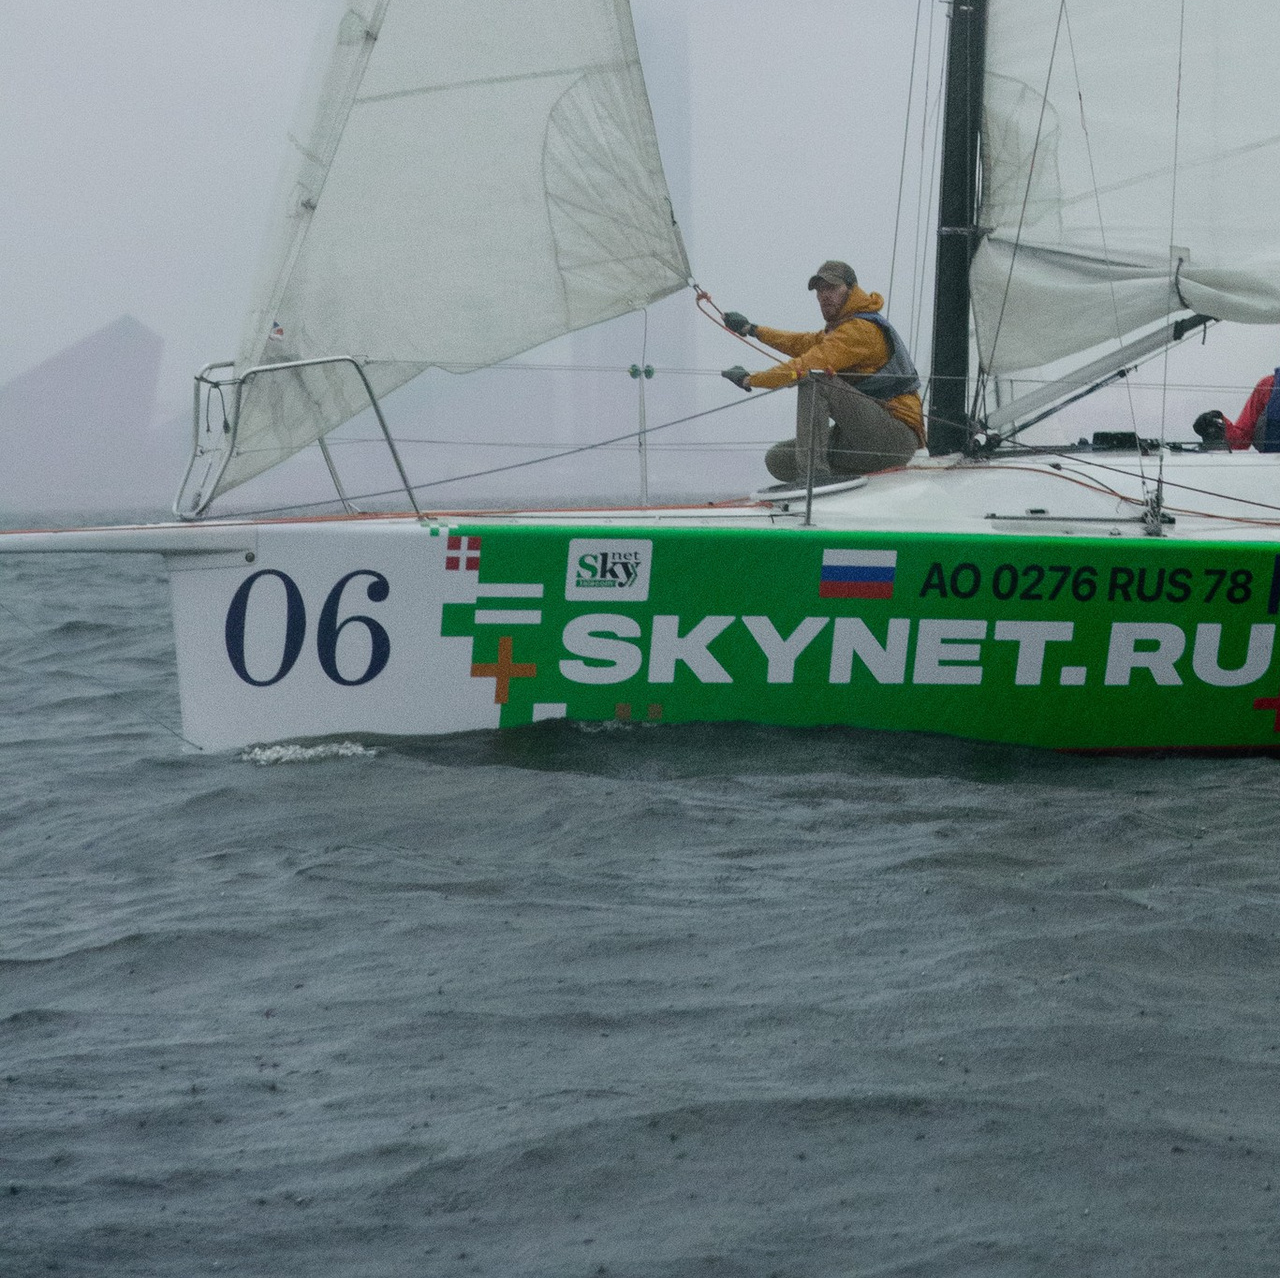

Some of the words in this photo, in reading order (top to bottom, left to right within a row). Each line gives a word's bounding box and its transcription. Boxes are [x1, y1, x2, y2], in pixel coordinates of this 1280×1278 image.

[992, 564, 1098, 602] 0276
[1107, 567, 1193, 603] RUS
[1203, 569, 1254, 605] 78
[225, 569, 391, 686] 06
[558, 612, 1276, 686] SKYNET.RU
